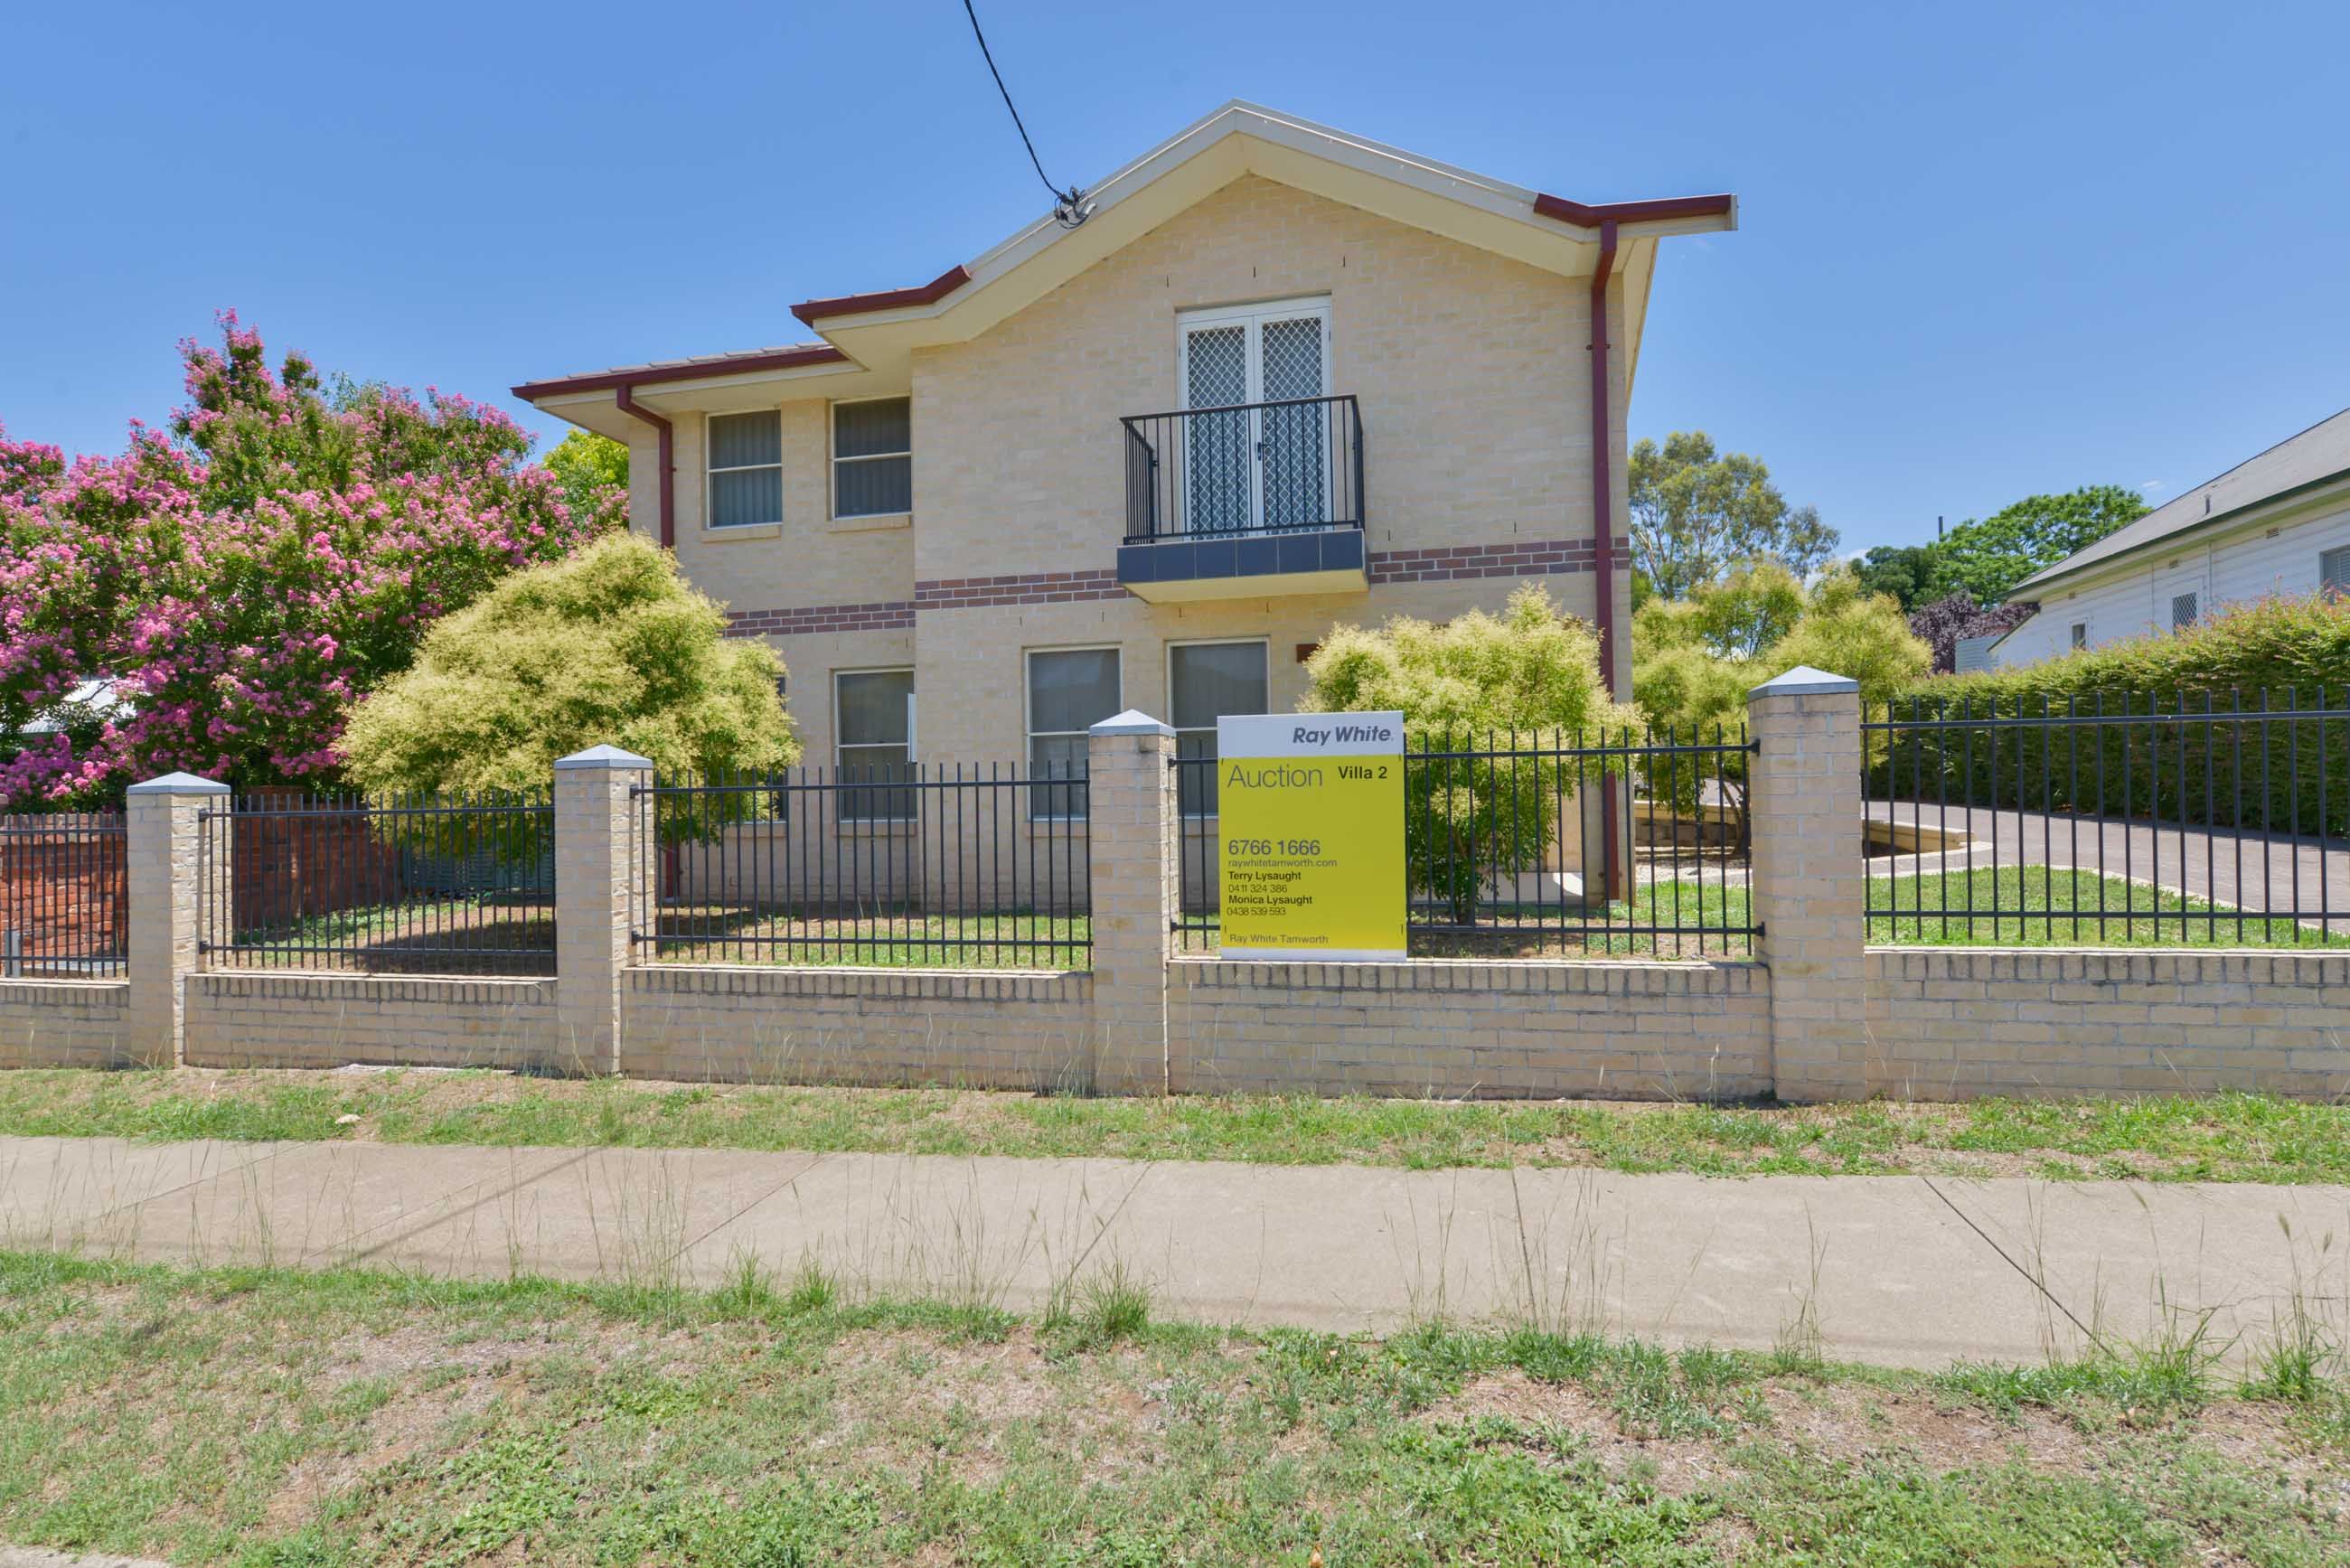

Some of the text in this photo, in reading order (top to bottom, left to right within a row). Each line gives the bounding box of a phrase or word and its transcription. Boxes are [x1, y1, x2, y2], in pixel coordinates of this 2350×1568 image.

[1292, 726, 1391, 746] Ray White
[1227, 765, 1323, 788] Auction
[1338, 765, 1387, 779] Villa 2
[1228, 840, 1321, 856] 6766 1666
[1228, 859, 1338, 869] raywhitetamworth.com
[1228, 871, 1301, 882] Terry Lysaught
[1250, 884, 1267, 893] 324
[1270, 884, 1287, 893] 386
[1228, 896, 1312, 906] Monica Lysaught
[1227, 907, 1249, 915] 0438
[1229, 934, 1329, 944] Ray White Tamworth
